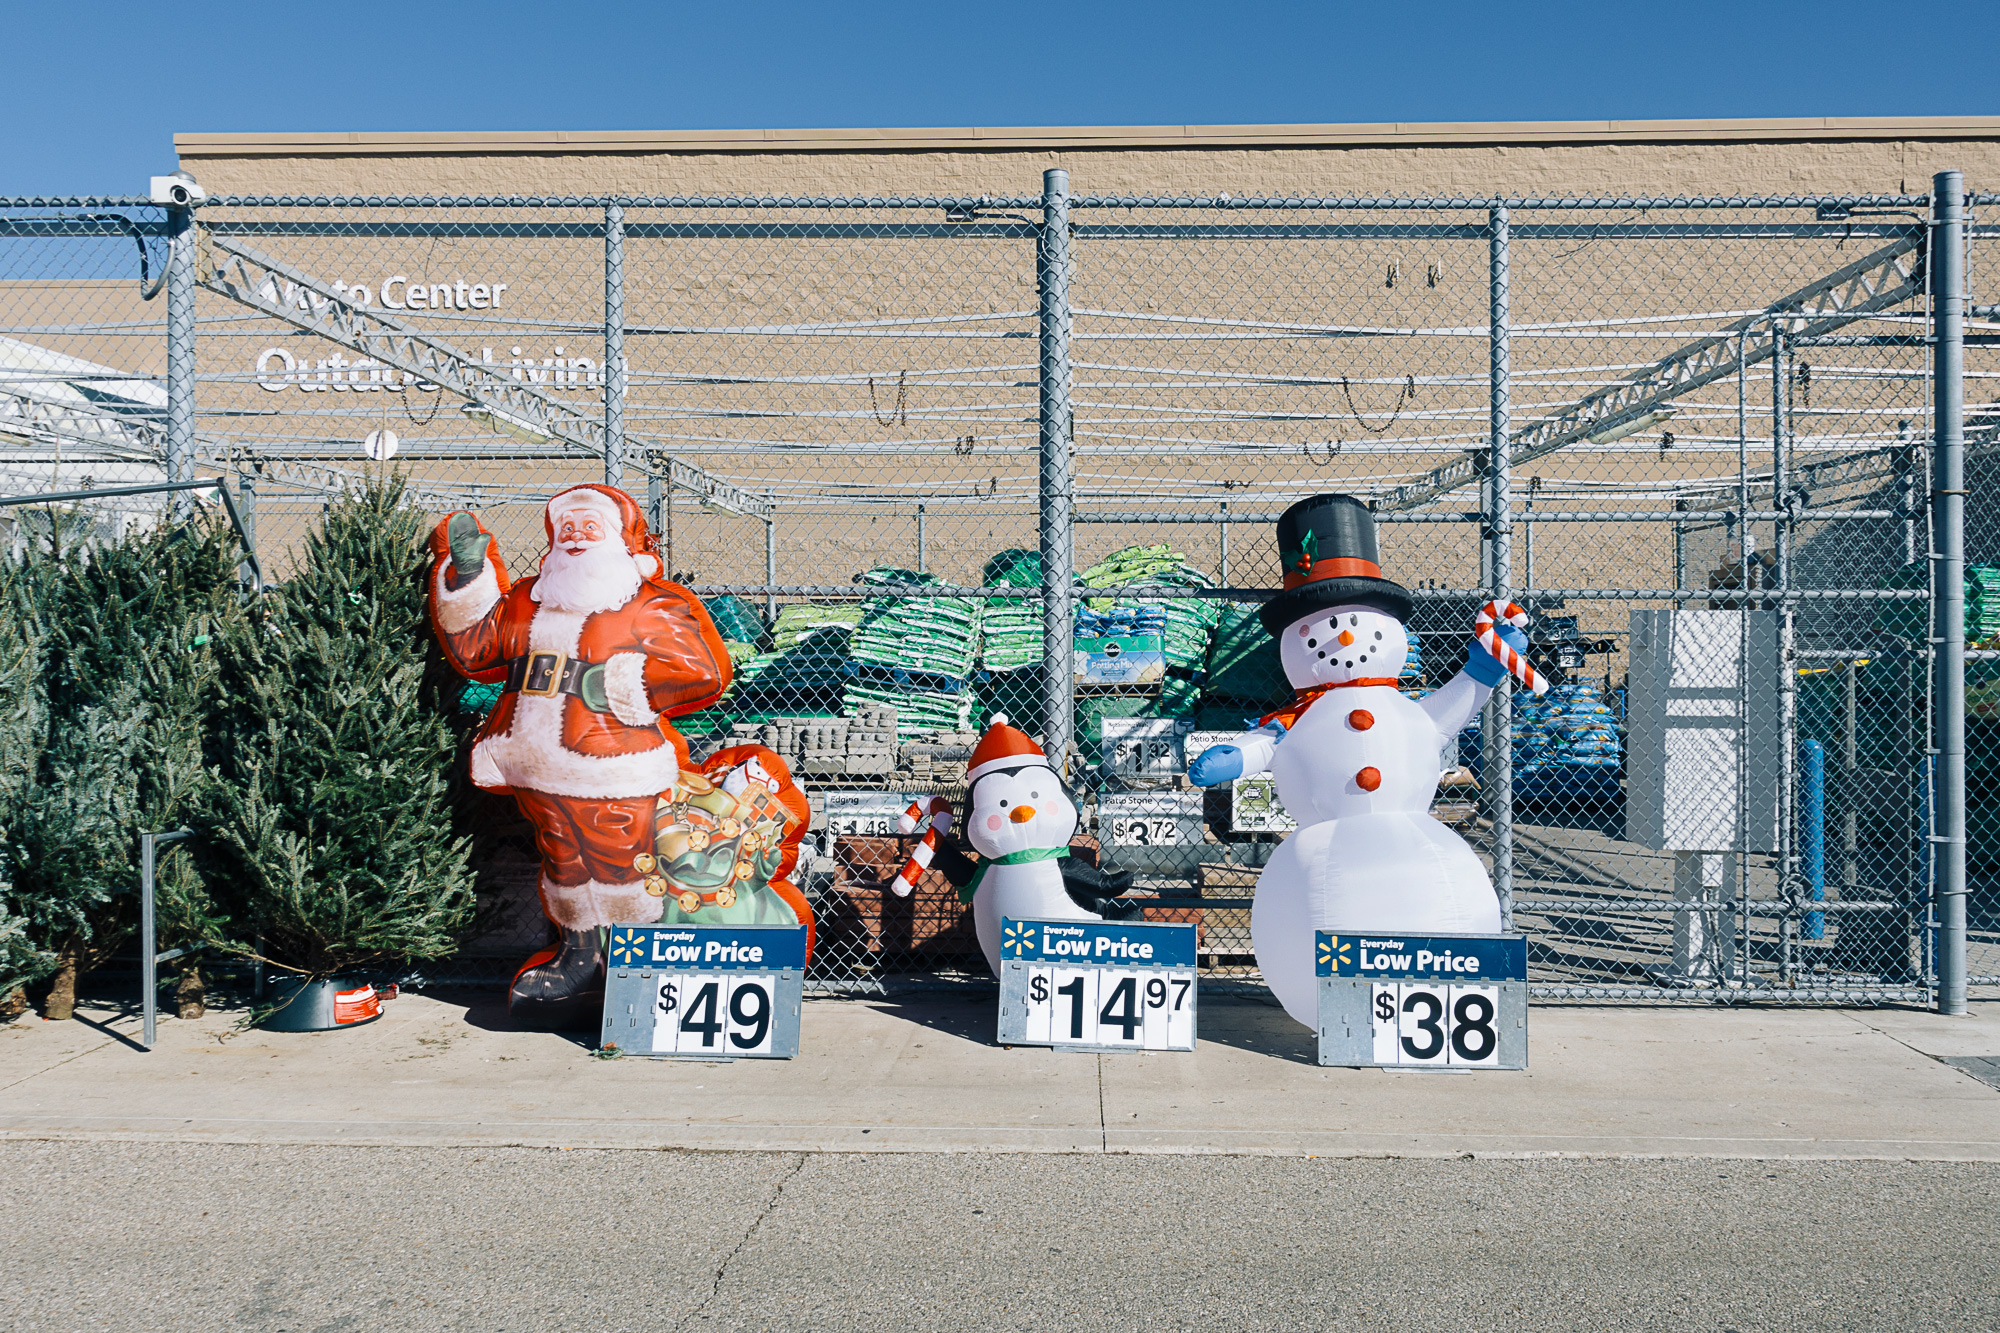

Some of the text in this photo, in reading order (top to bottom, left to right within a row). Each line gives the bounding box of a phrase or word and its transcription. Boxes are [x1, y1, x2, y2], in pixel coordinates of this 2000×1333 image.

[380, 275, 507, 310] Center
[256, 348, 467, 392] Outdo
[1091, 661, 1120, 671] Potting
[1190, 735, 1232, 743] Patio Stone
[830, 795, 860, 806] Edging
[1104, 796, 1153, 805] Patio Stone
[653, 931, 696, 943] Everyday
[1043, 925, 1085, 938] Everyday
[1042, 934, 1154, 959] Low Price
[1360, 938, 1405, 951] Everyday
[651, 940, 764, 963] Low Price
[1359, 948, 1480, 973] Low Price
